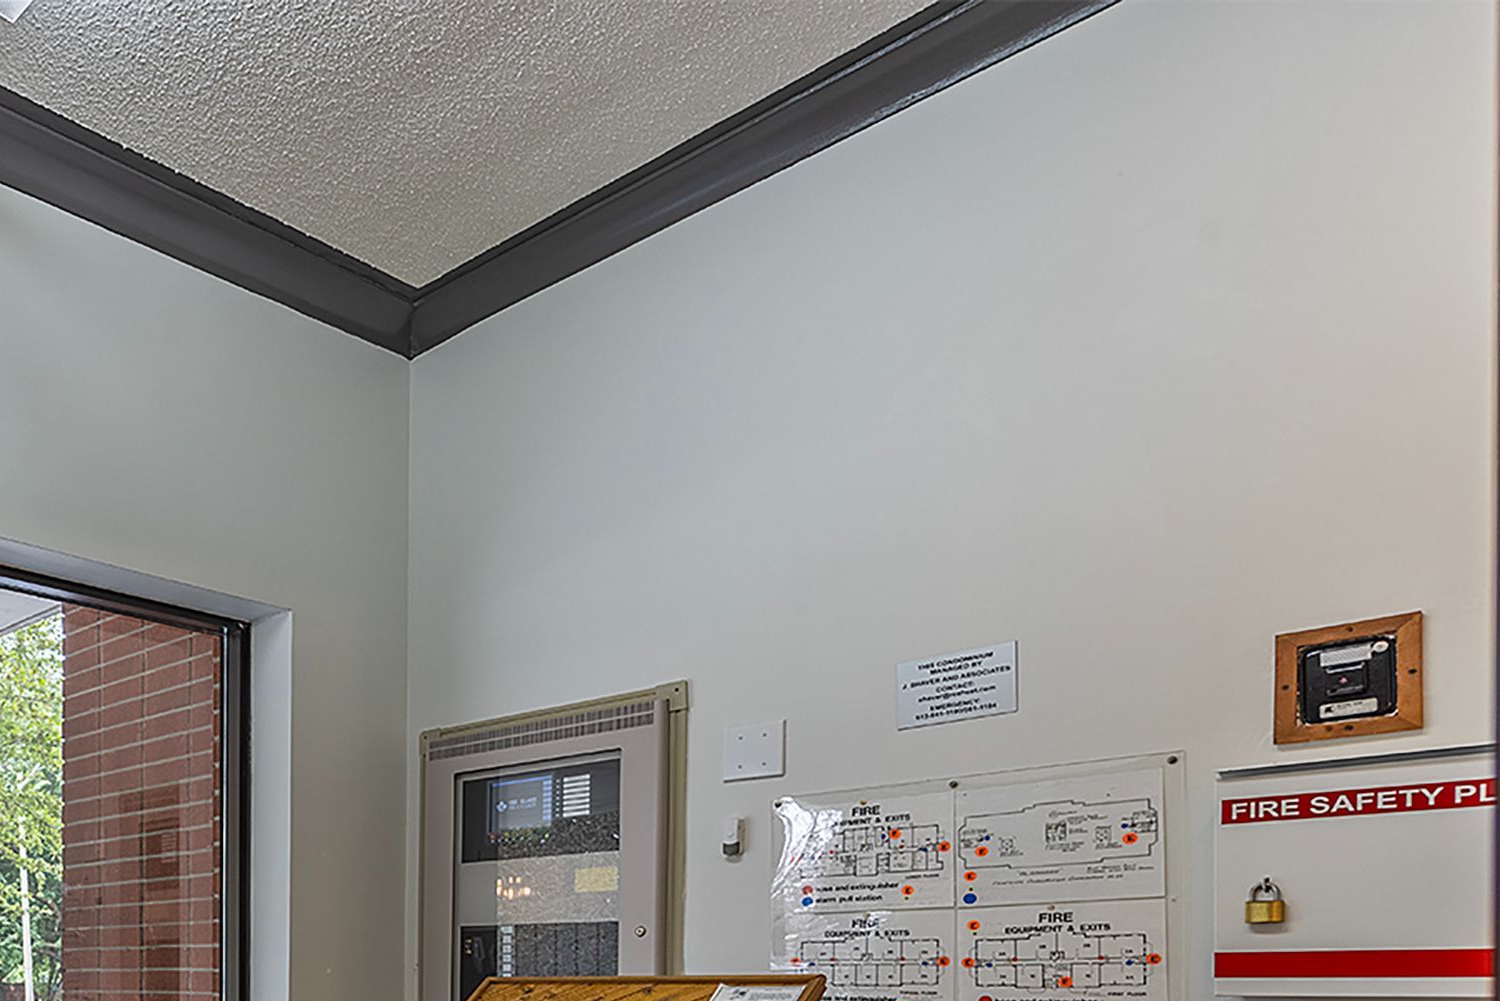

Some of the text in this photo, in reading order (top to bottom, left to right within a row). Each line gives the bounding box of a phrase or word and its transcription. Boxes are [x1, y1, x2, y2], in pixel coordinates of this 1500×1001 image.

[1230, 798, 1301, 820] FIRE
[1309, 786, 1445, 815] SAFETY
[851, 805, 880, 816] FIRE
[885, 814, 911, 823] EXITS
[1038, 912, 1074, 923] FIRE
[1004, 924, 1064, 934] EQUIPMENT
[1079, 923, 1111, 932] EXITS
